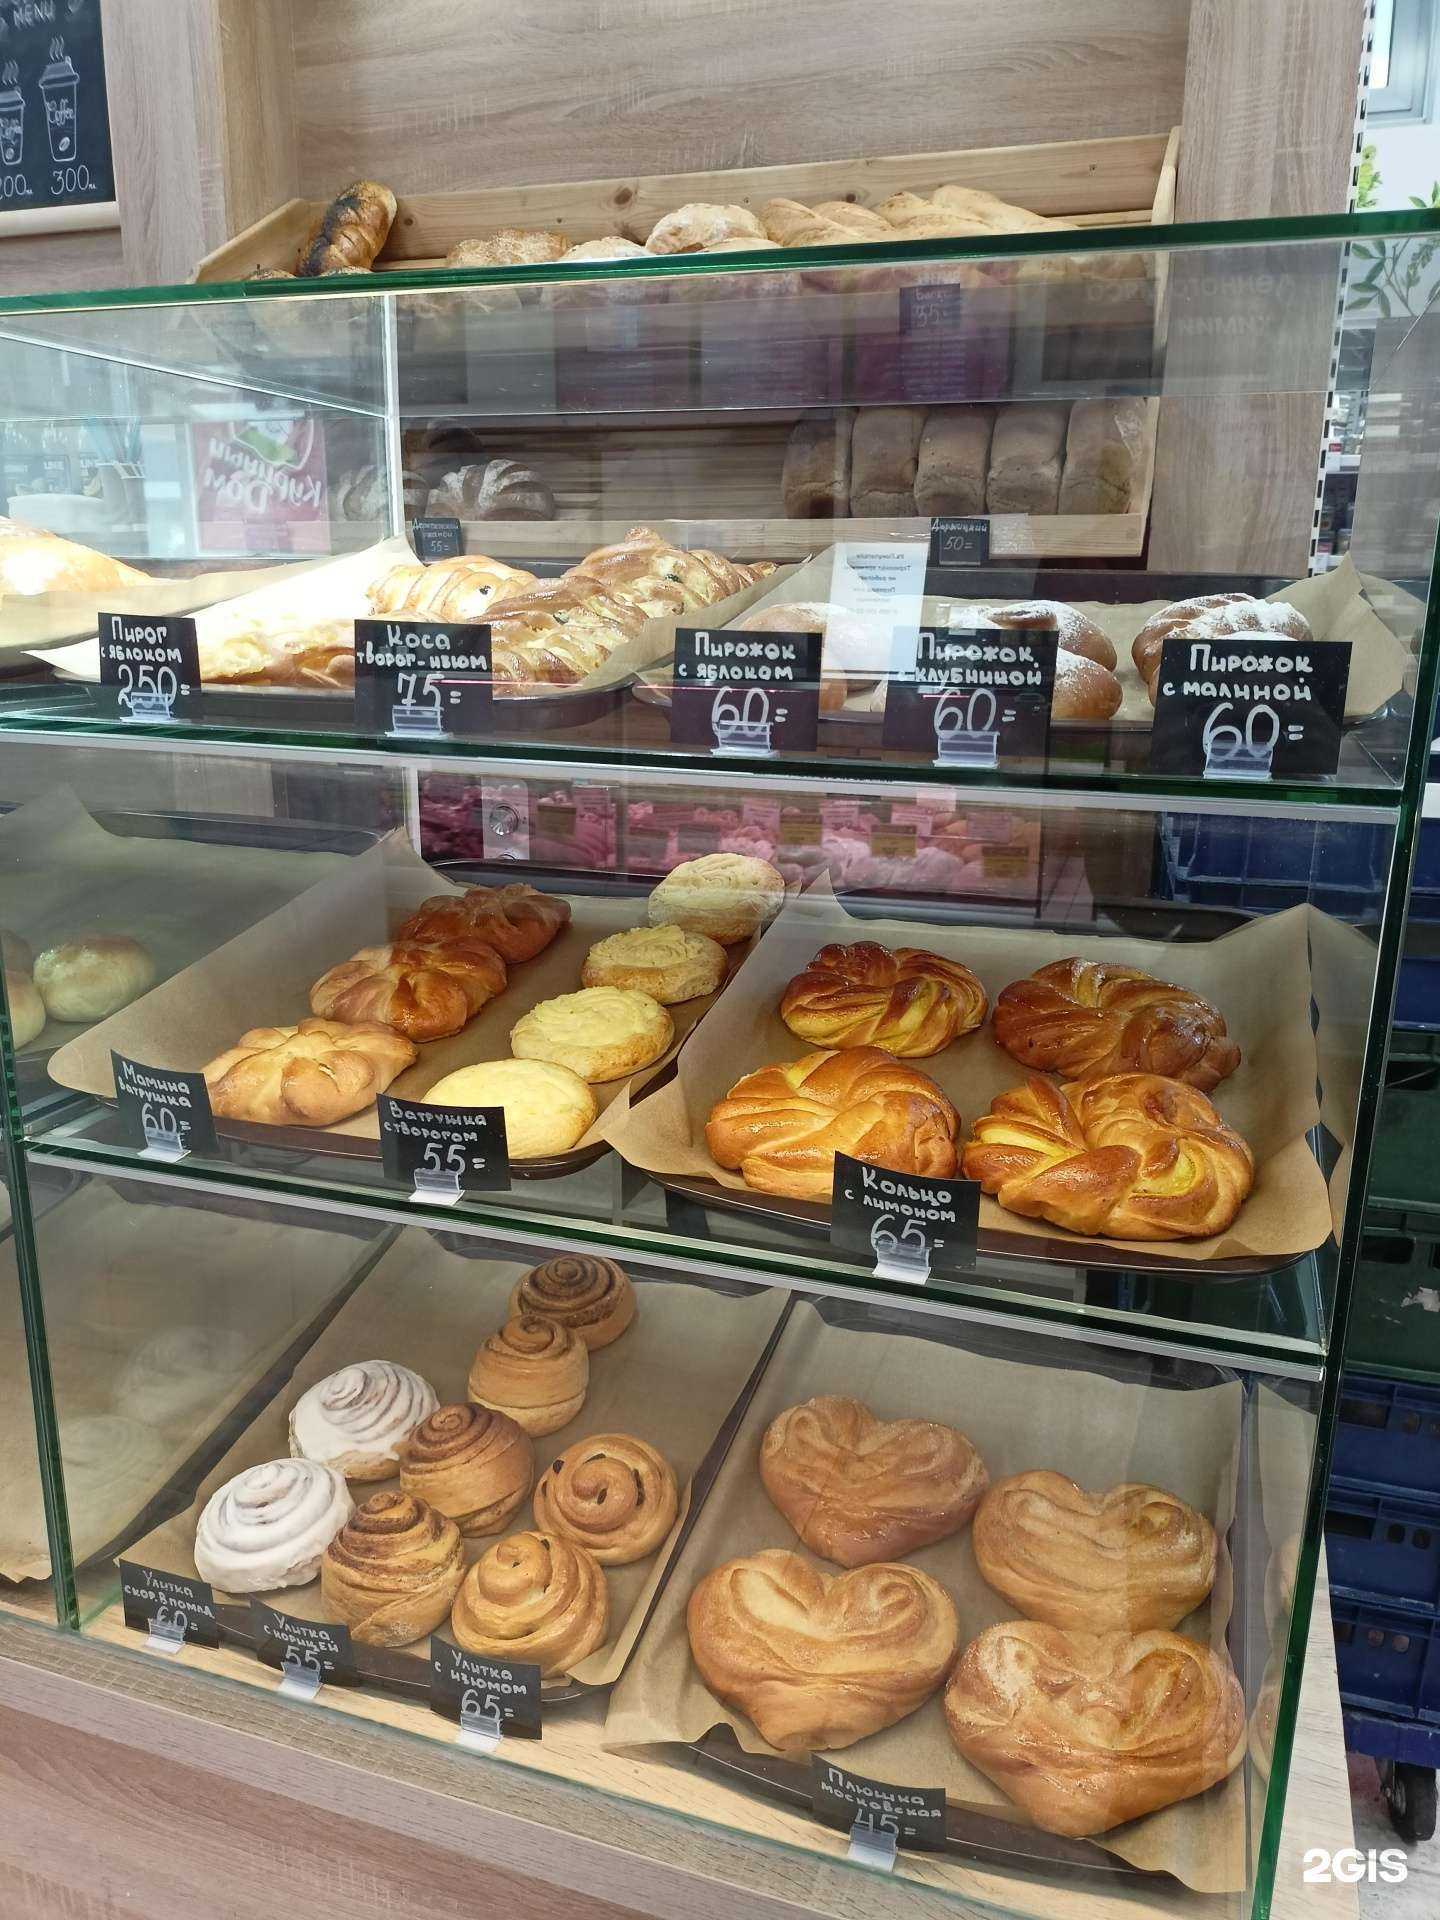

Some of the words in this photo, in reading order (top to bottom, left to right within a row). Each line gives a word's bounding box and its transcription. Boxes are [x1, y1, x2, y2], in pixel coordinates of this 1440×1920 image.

[111, 615, 168, 645] Пирог
[387, 624, 451, 650] Коса
[109, 644, 183, 664] яблоком
[694, 631, 796, 661] Пирожок
[917, 631, 1034, 663] Пирожок
[1189, 643, 1314, 673] Пирожок
[678, 663, 688, 677] с
[696, 663, 794, 682] яблоком
[915, 661, 1042, 693] клубникой
[1162, 682, 1175, 696] с
[1183, 677, 1312, 701] малиной
[122, 1060, 191, 1095] Мамина
[389, 1100, 487, 1126] Ватрушка
[862, 1166, 952, 1207] Кольцо
[844, 1188, 855, 1200] с
[863, 1194, 956, 1223] лимоном
[142, 1569, 194, 1599] Улитка
[273, 1612, 331, 1641] Улитка
[434, 1661, 441, 1673] с
[451, 1648, 513, 1681] Улитка
[828, 1767, 925, 1806] Плюшка
